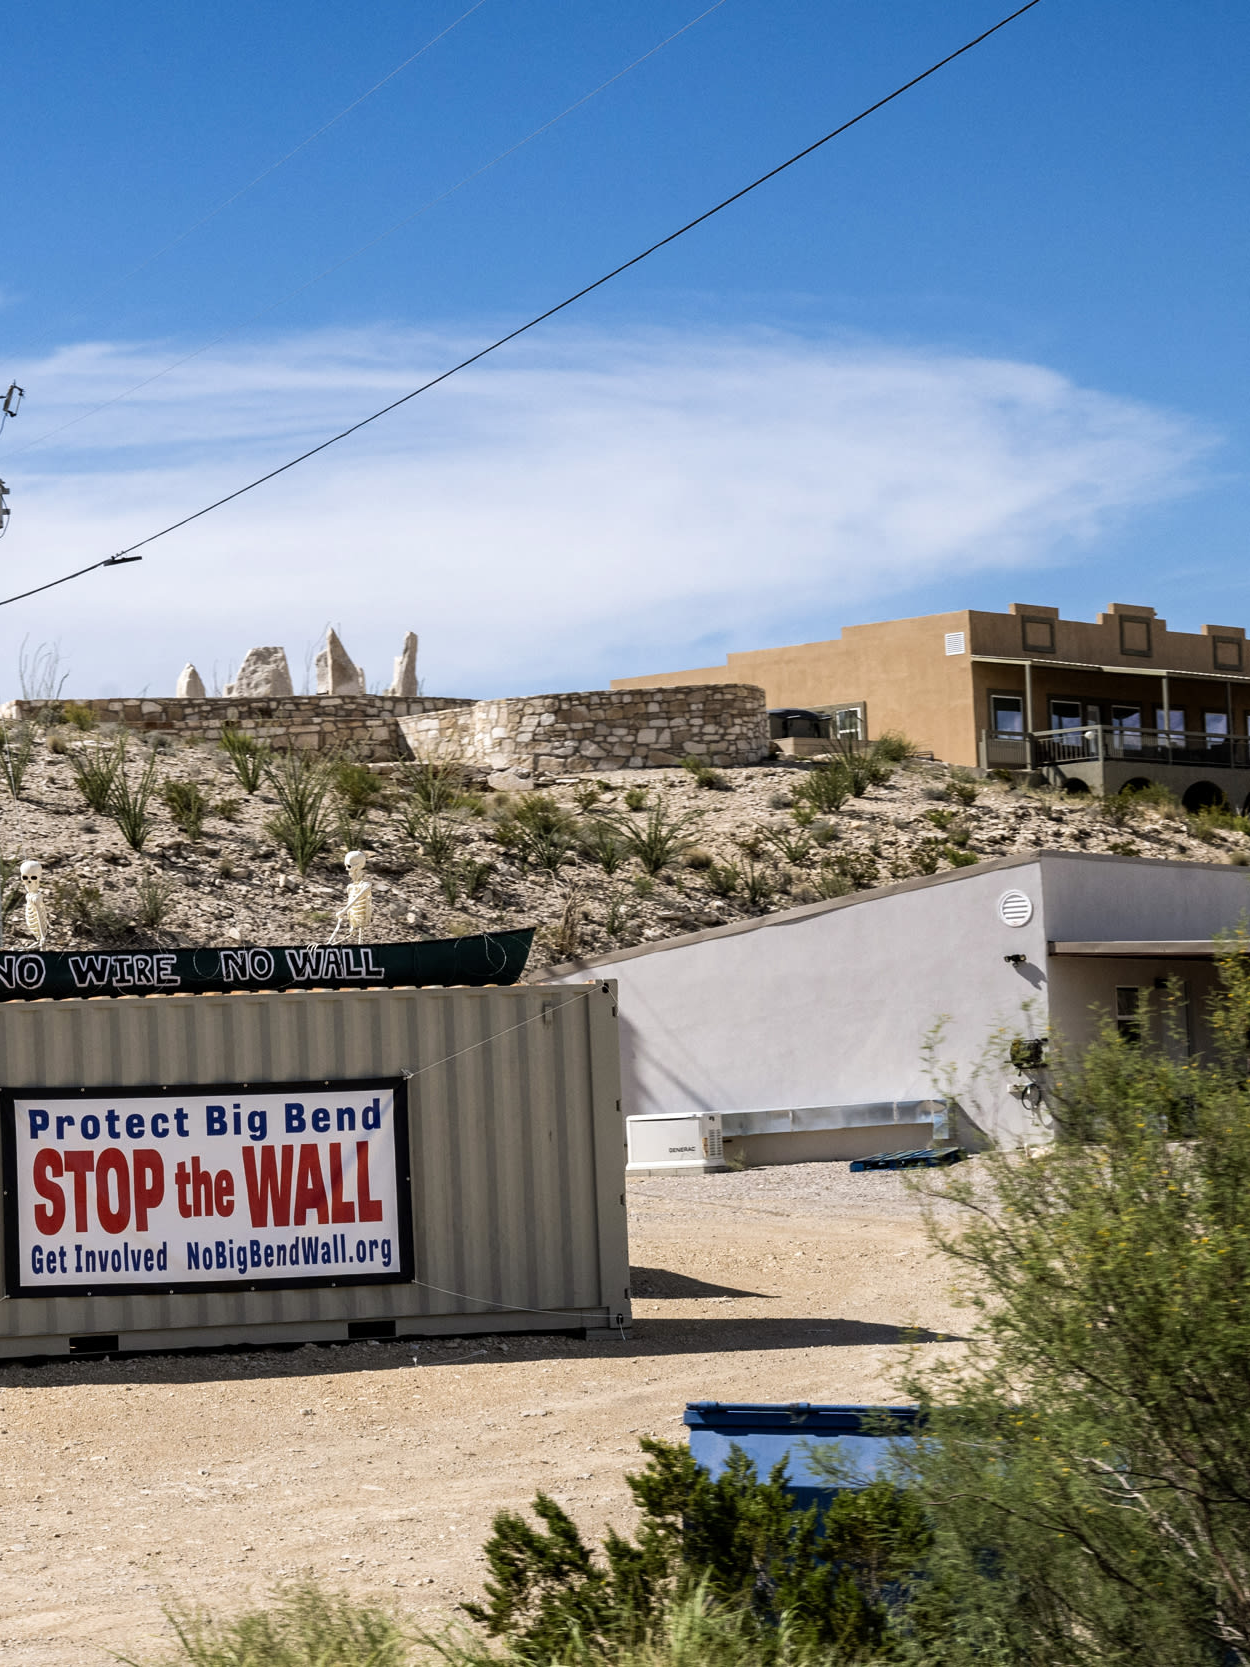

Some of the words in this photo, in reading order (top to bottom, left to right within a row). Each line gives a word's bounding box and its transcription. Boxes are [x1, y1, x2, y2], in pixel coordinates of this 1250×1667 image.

[68, 954, 181, 988] WIRE
[220, 948, 275, 982] NO
[285, 948, 385, 981] WALL
[28, 1107, 189, 1140] Protect
[205, 1103, 267, 1141] Big
[285, 1098, 381, 1134] Bend
[33, 1147, 165, 1236] STOP
[174, 1155, 235, 1219] the
[242, 1140, 383, 1228] WALL
[31, 1244, 67, 1274] Get
[75, 1241, 167, 1273] Involved
[186, 1234, 392, 1274] NoBigBendWall.org
